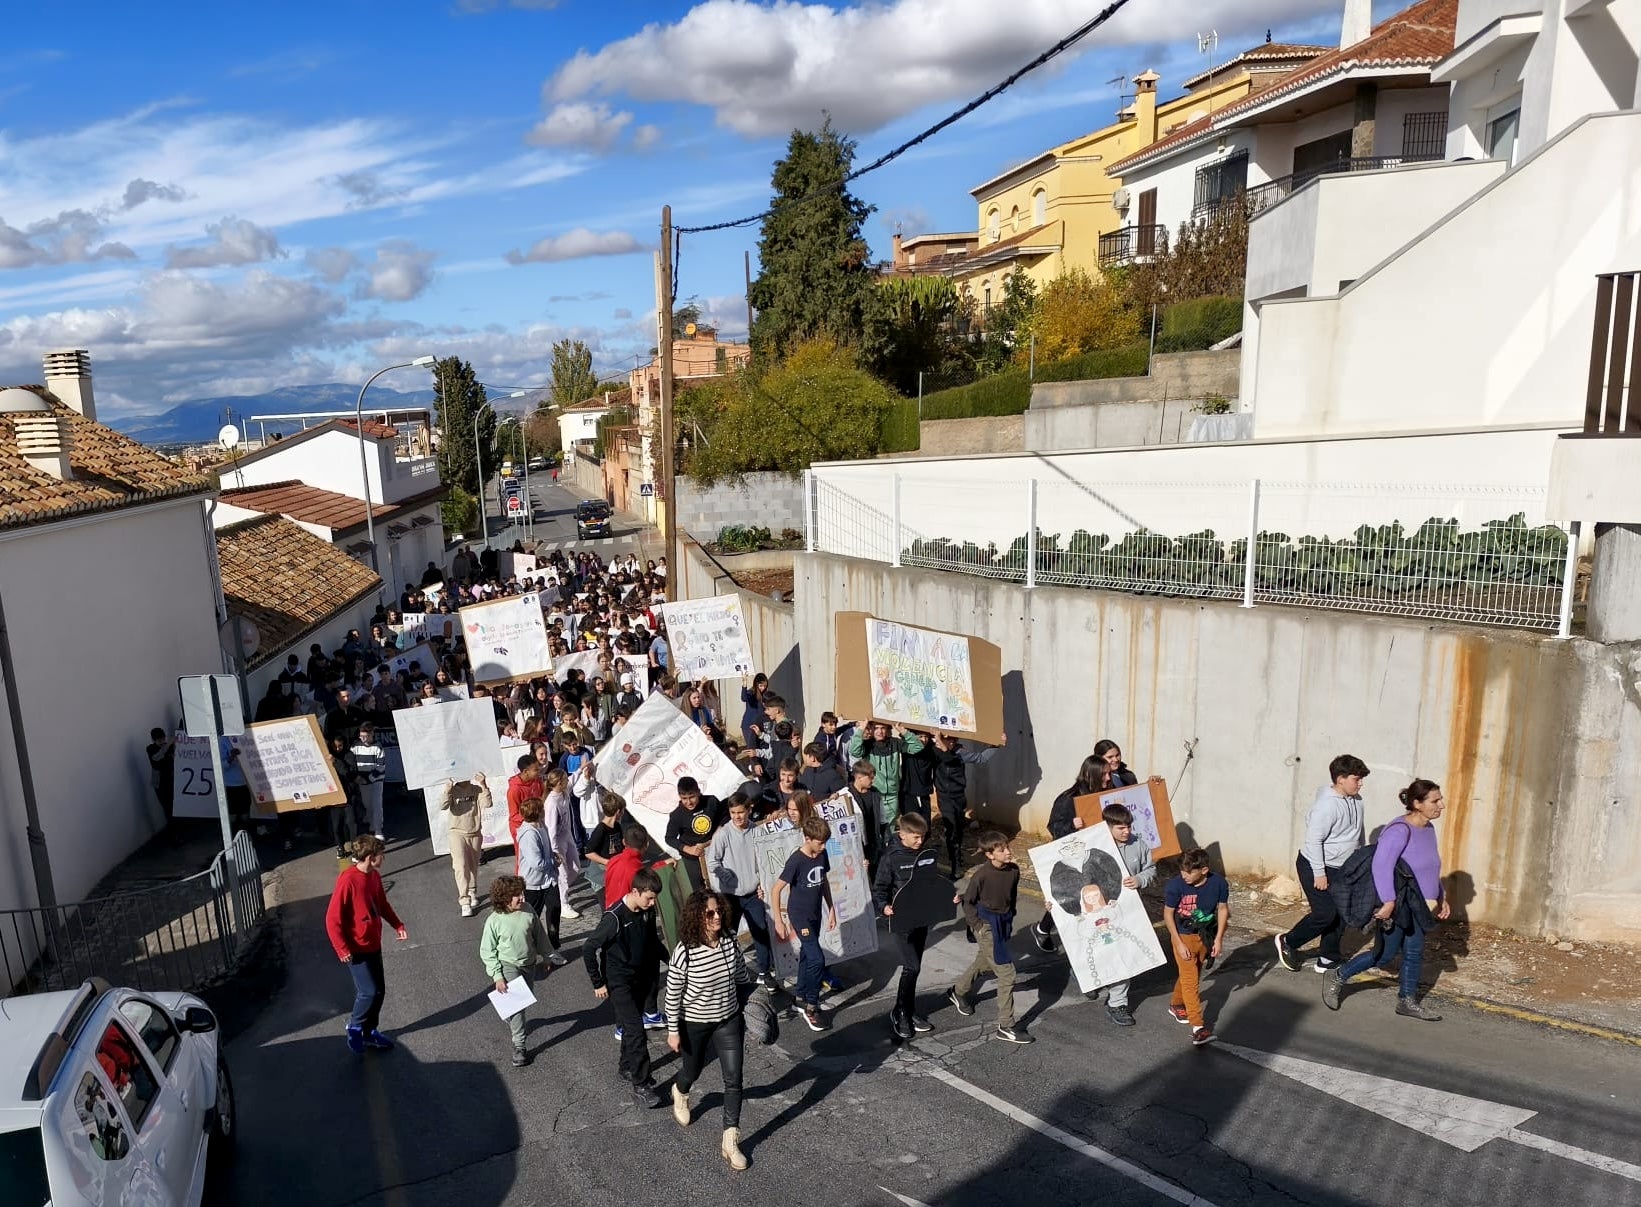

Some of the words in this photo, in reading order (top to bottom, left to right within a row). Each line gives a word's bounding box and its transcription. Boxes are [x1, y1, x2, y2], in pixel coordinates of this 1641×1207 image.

[876, 621, 919, 657] FIN
[875, 647, 962, 683] VIOLENCIA
[181, 767, 214, 796] 25
